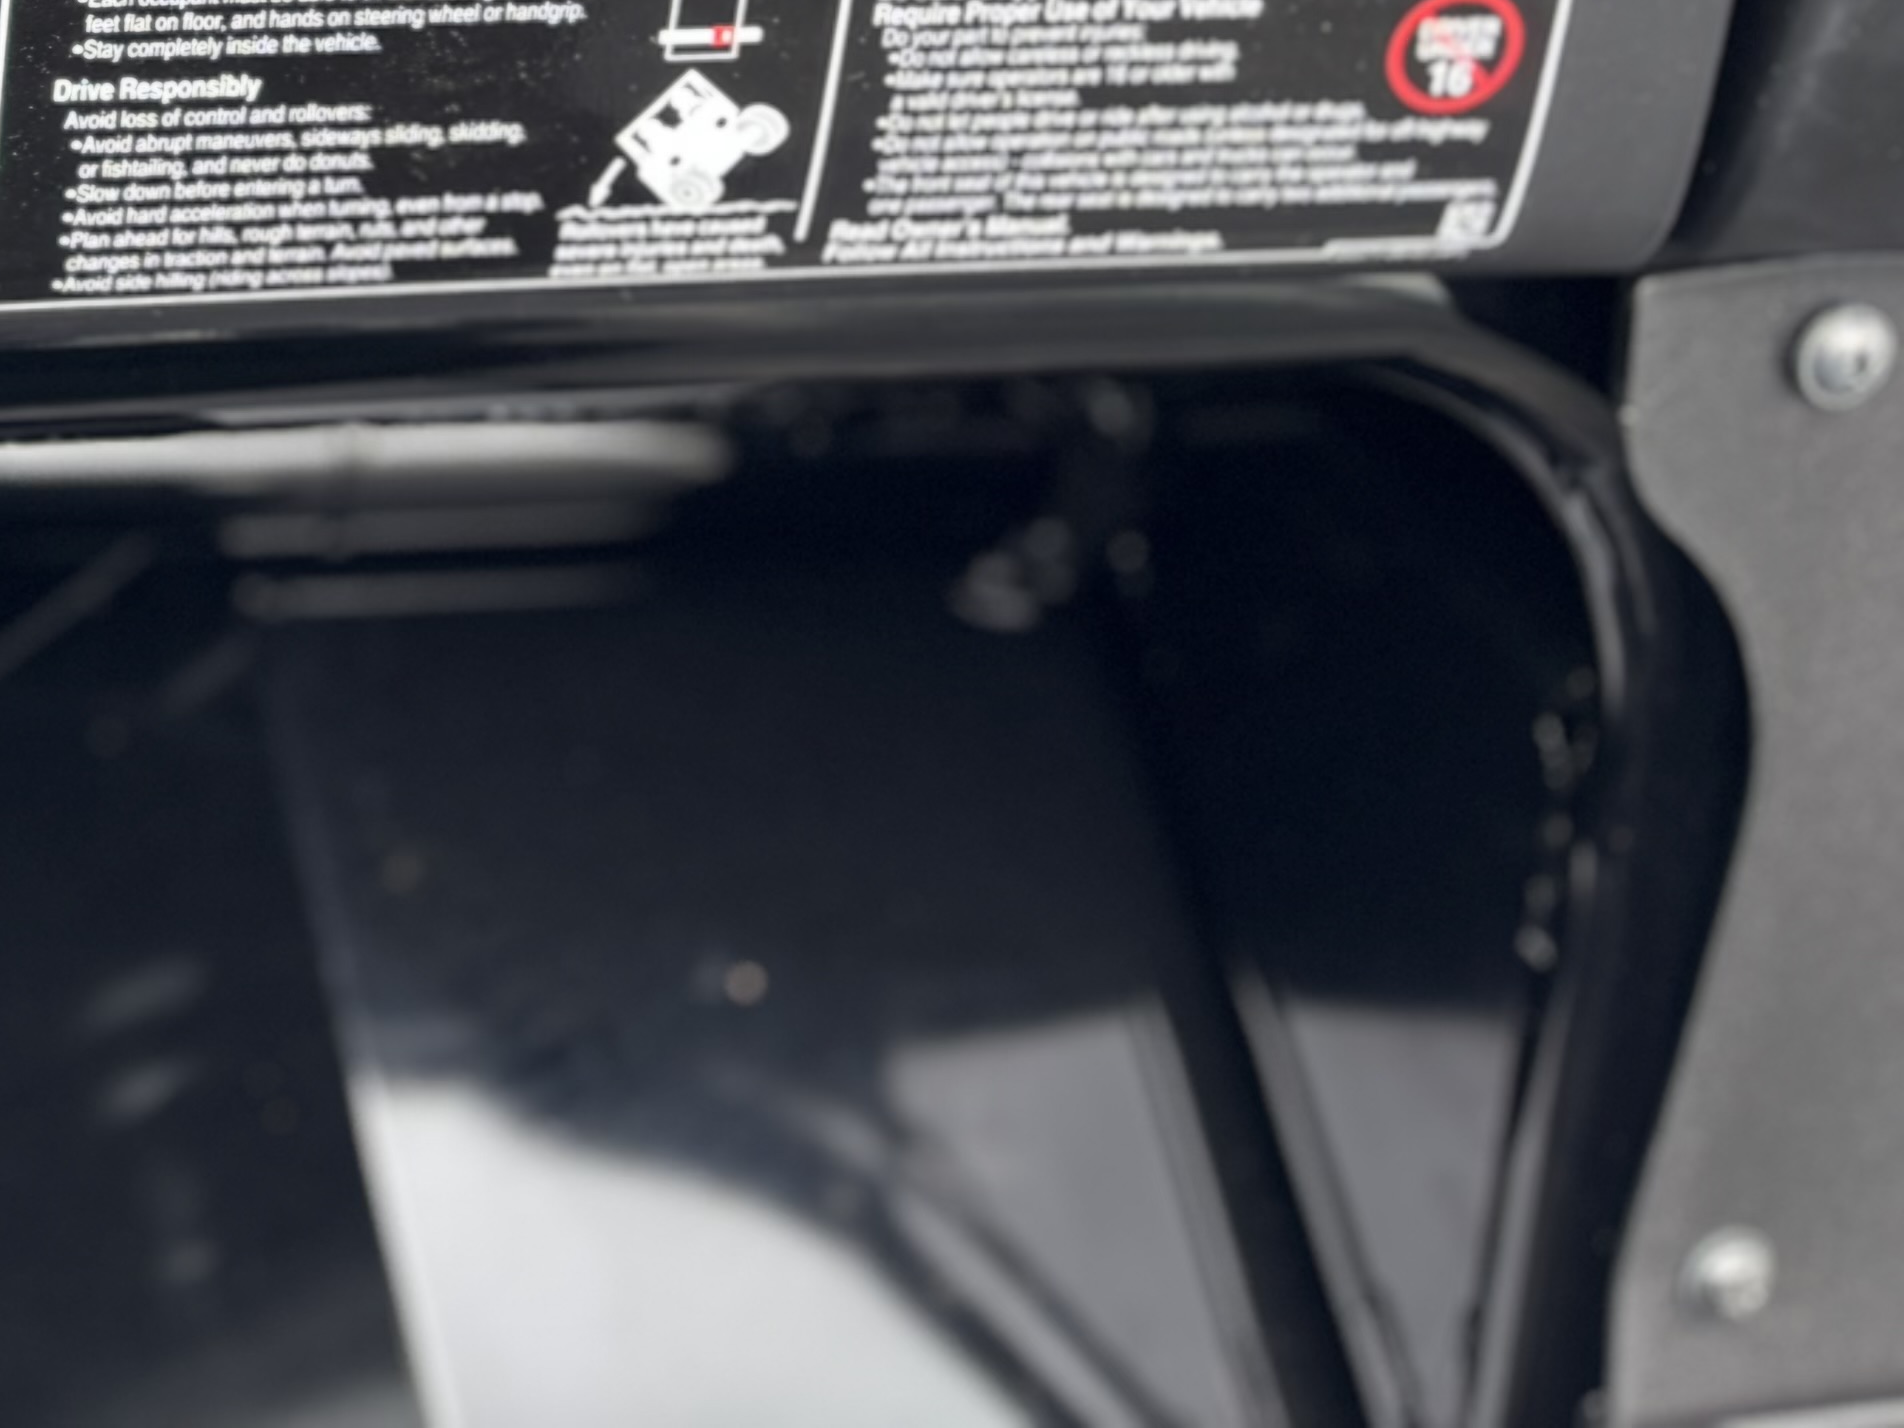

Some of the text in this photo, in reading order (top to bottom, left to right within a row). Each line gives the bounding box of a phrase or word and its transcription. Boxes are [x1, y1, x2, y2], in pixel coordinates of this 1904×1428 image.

[83, 38, 124, 61] Stay
[126, 36, 222, 61] completely
[225, 34, 278, 55] inside
[281, 33, 312, 54] the
[52, 73, 261, 104] Drive Responsibly
